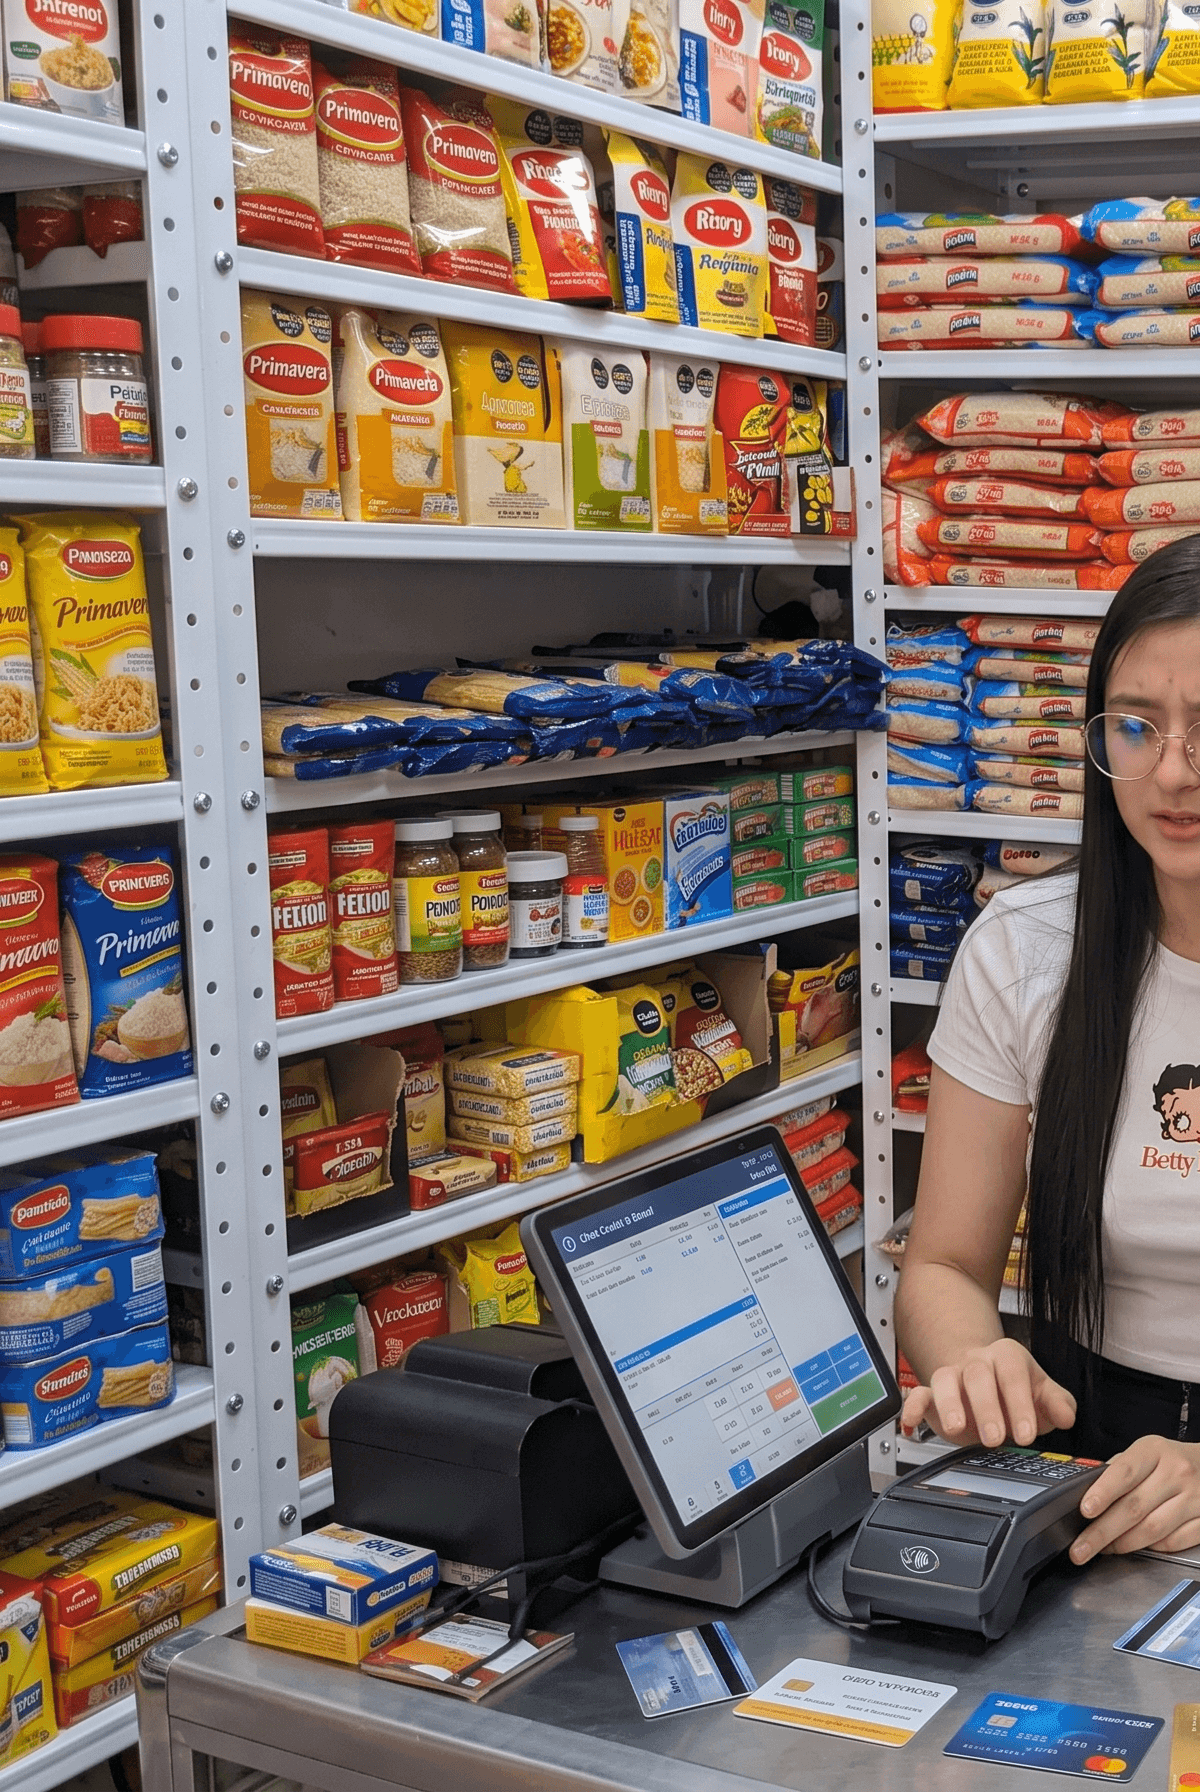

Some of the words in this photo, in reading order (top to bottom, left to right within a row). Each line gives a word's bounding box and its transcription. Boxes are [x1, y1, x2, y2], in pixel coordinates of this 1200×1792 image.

[325, 99, 398, 132] Primavera
[432, 136, 497, 166] Primavera
[249, 354, 328, 382] Primavera
[1140, 1146, 1195, 1178] Betty
